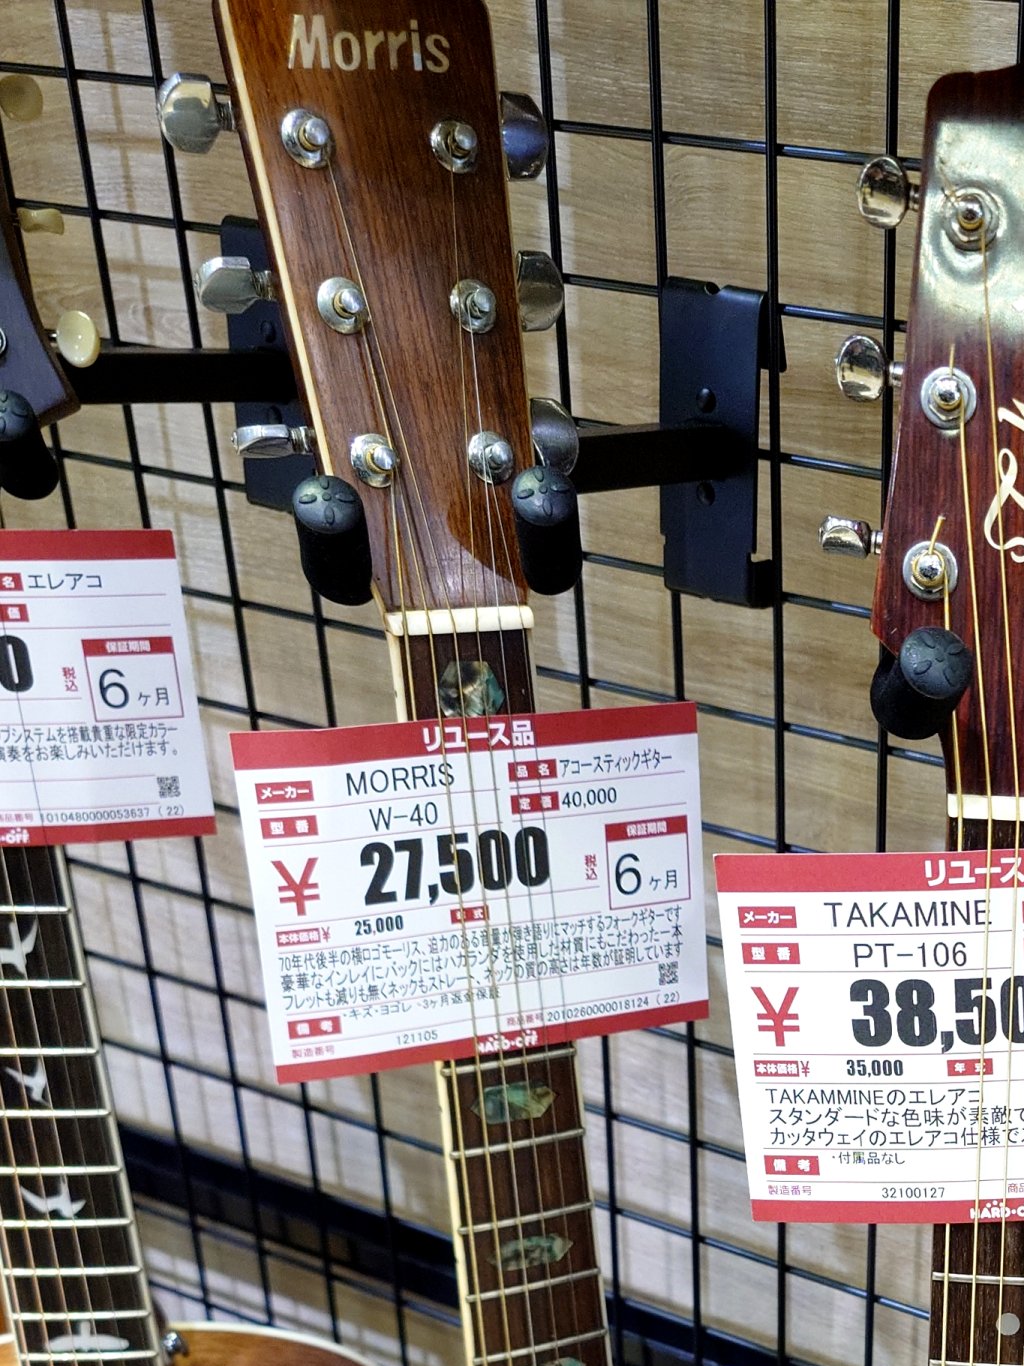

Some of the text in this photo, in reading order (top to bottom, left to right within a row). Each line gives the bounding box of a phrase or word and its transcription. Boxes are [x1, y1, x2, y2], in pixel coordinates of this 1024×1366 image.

[287, 14, 450, 73] Morris
[28, 572, 102, 590] エレアコ
[423, 719, 535, 752] リユース品
[559, 748, 672, 778] アコースティックギター
[261, 762, 455, 799] メーカー MORRIS
[561, 787, 617, 809] 40,000
[369, 801, 438, 832] W-40
[360, 826, 550, 905] 27,500
[354, 915, 404, 936] 25,000
[743, 900, 992, 928] メーカー TAKAMINE
[853, 942, 967, 968] PT-106
[397, 1030, 438, 1046] 121105
[846, 1059, 904, 1078] 35,000
[881, 1187, 945, 1199] 32100127
